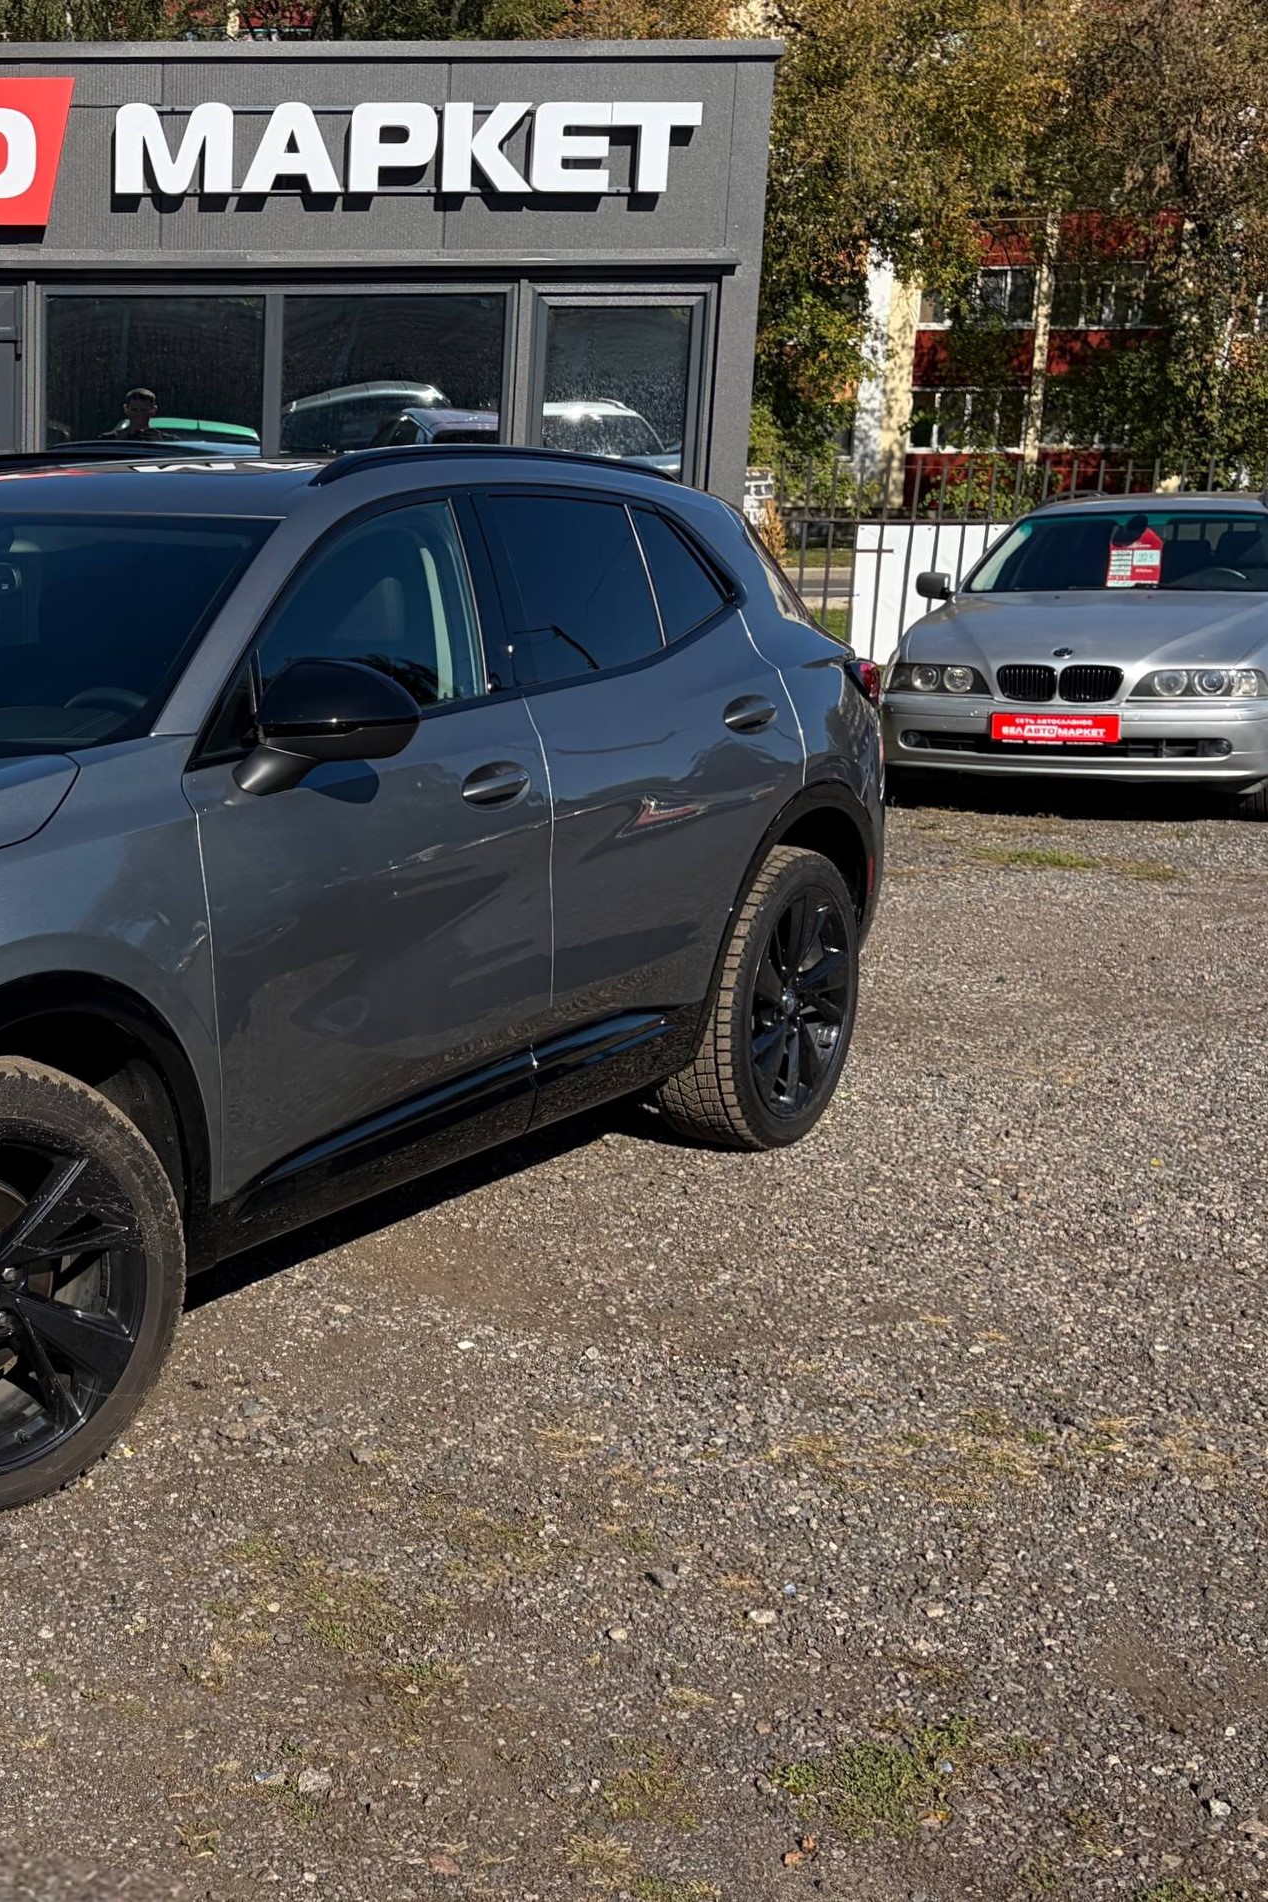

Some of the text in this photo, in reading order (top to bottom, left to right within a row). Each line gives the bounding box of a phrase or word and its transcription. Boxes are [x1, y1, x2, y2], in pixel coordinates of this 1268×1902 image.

[114, 101, 703, 195] МАРКЕТ
[1001, 726, 1107, 737] БЕЛ АВТО МАРКЕТ
